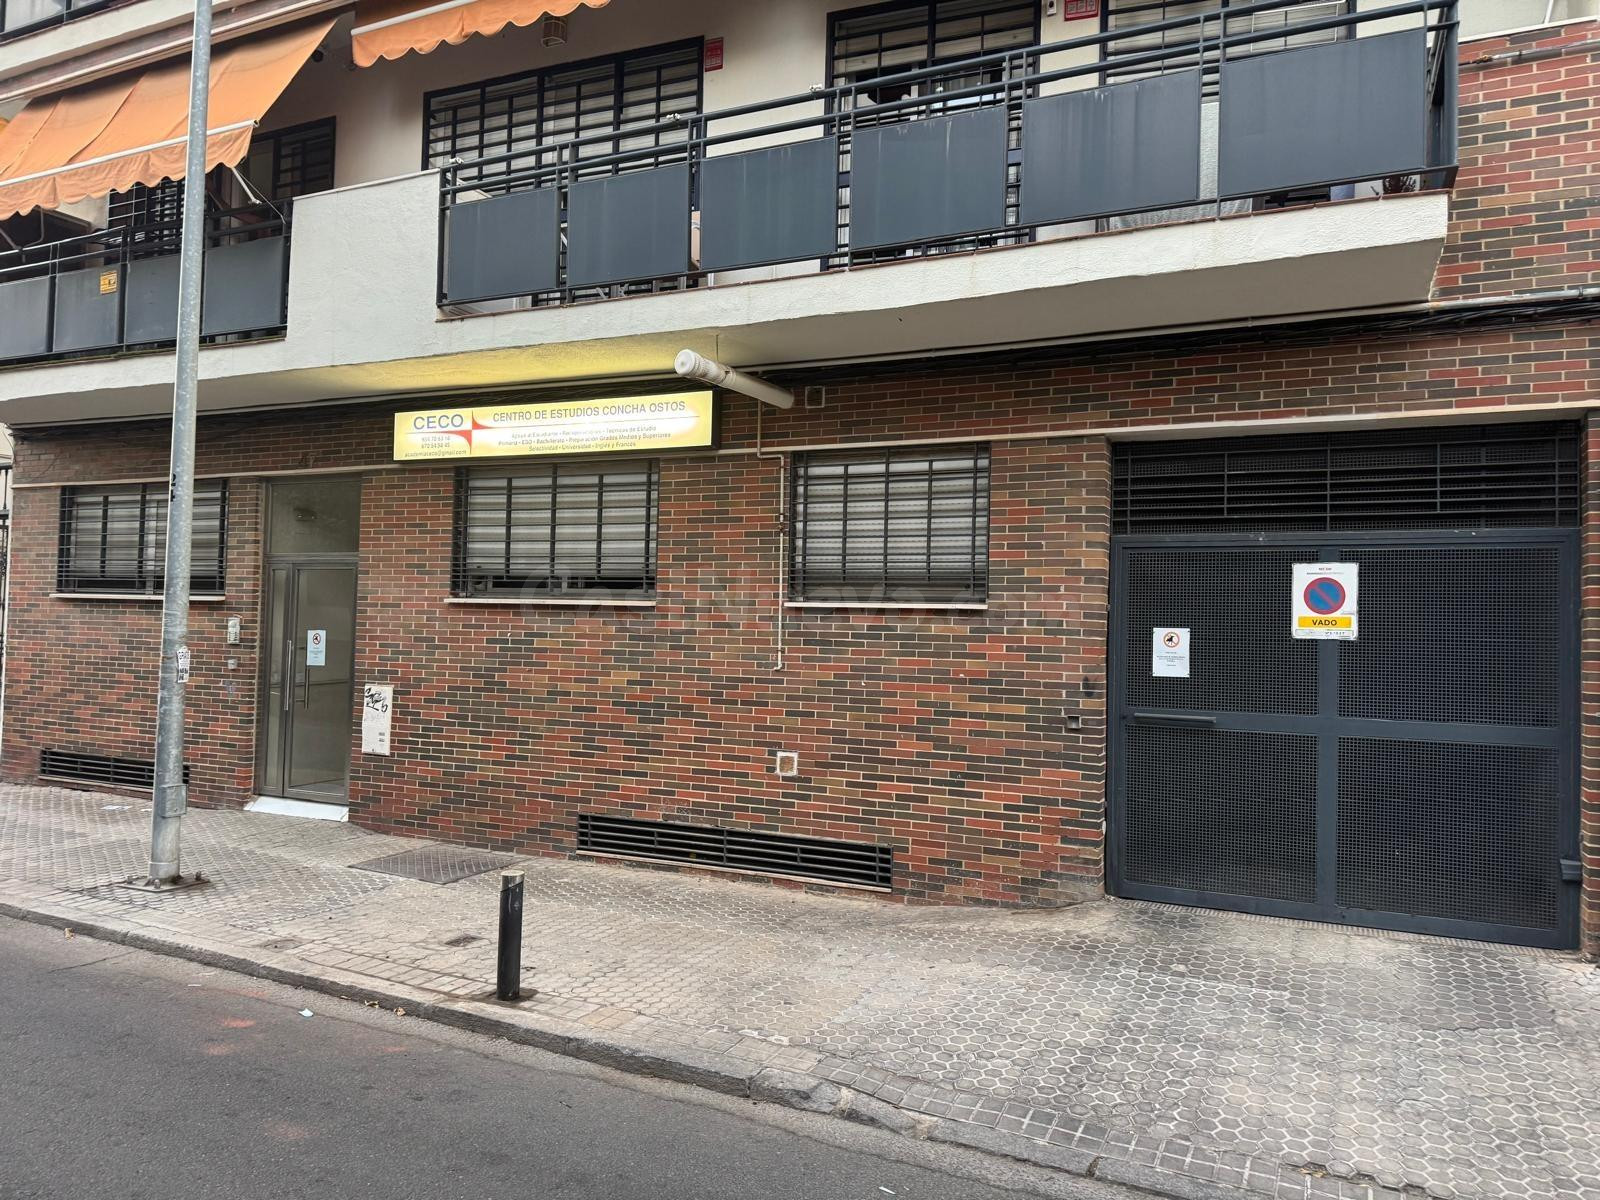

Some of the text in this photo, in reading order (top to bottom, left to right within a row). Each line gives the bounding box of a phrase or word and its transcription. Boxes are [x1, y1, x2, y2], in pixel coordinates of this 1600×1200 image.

[493, 400, 686, 422] CENTRO DE ESTUDIOS CONCHA OSTOS
[413, 413, 464, 430] CECO
